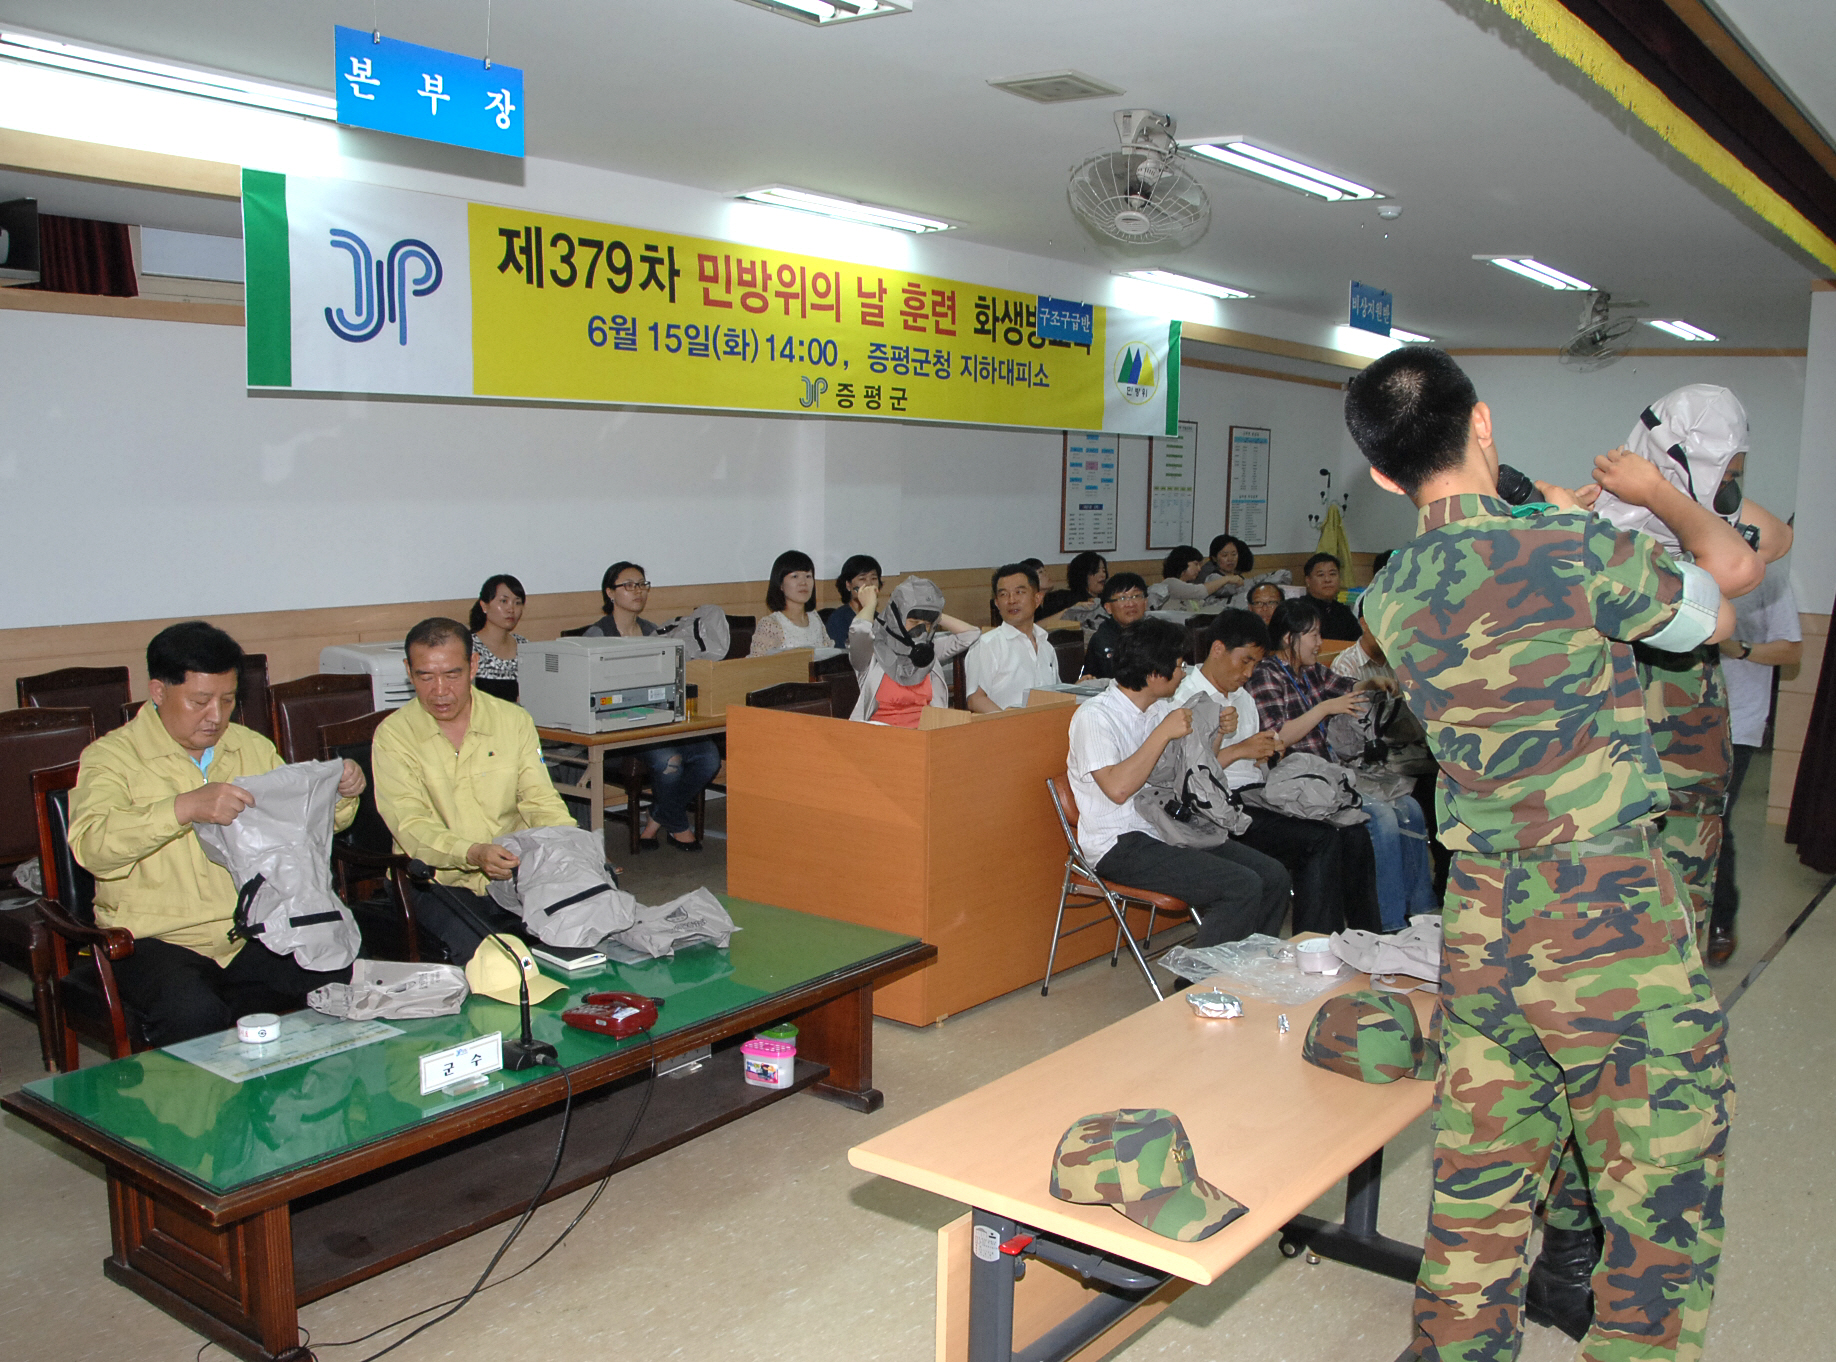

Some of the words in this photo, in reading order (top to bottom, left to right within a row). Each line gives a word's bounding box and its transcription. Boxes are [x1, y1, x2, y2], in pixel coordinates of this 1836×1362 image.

[497, 226, 681, 304] 제379차
[697, 253, 841, 323] 민방위의
[857, 276, 888, 328] 날
[899, 281, 957, 337] 훈련
[1040, 308, 1091, 333] 구조구급반
[587, 314, 638, 352] 6월
[867, 342, 952, 380] 증평군청
[960, 354, 1050, 389] 지하대피소
[835, 382, 908, 412] 증평군
